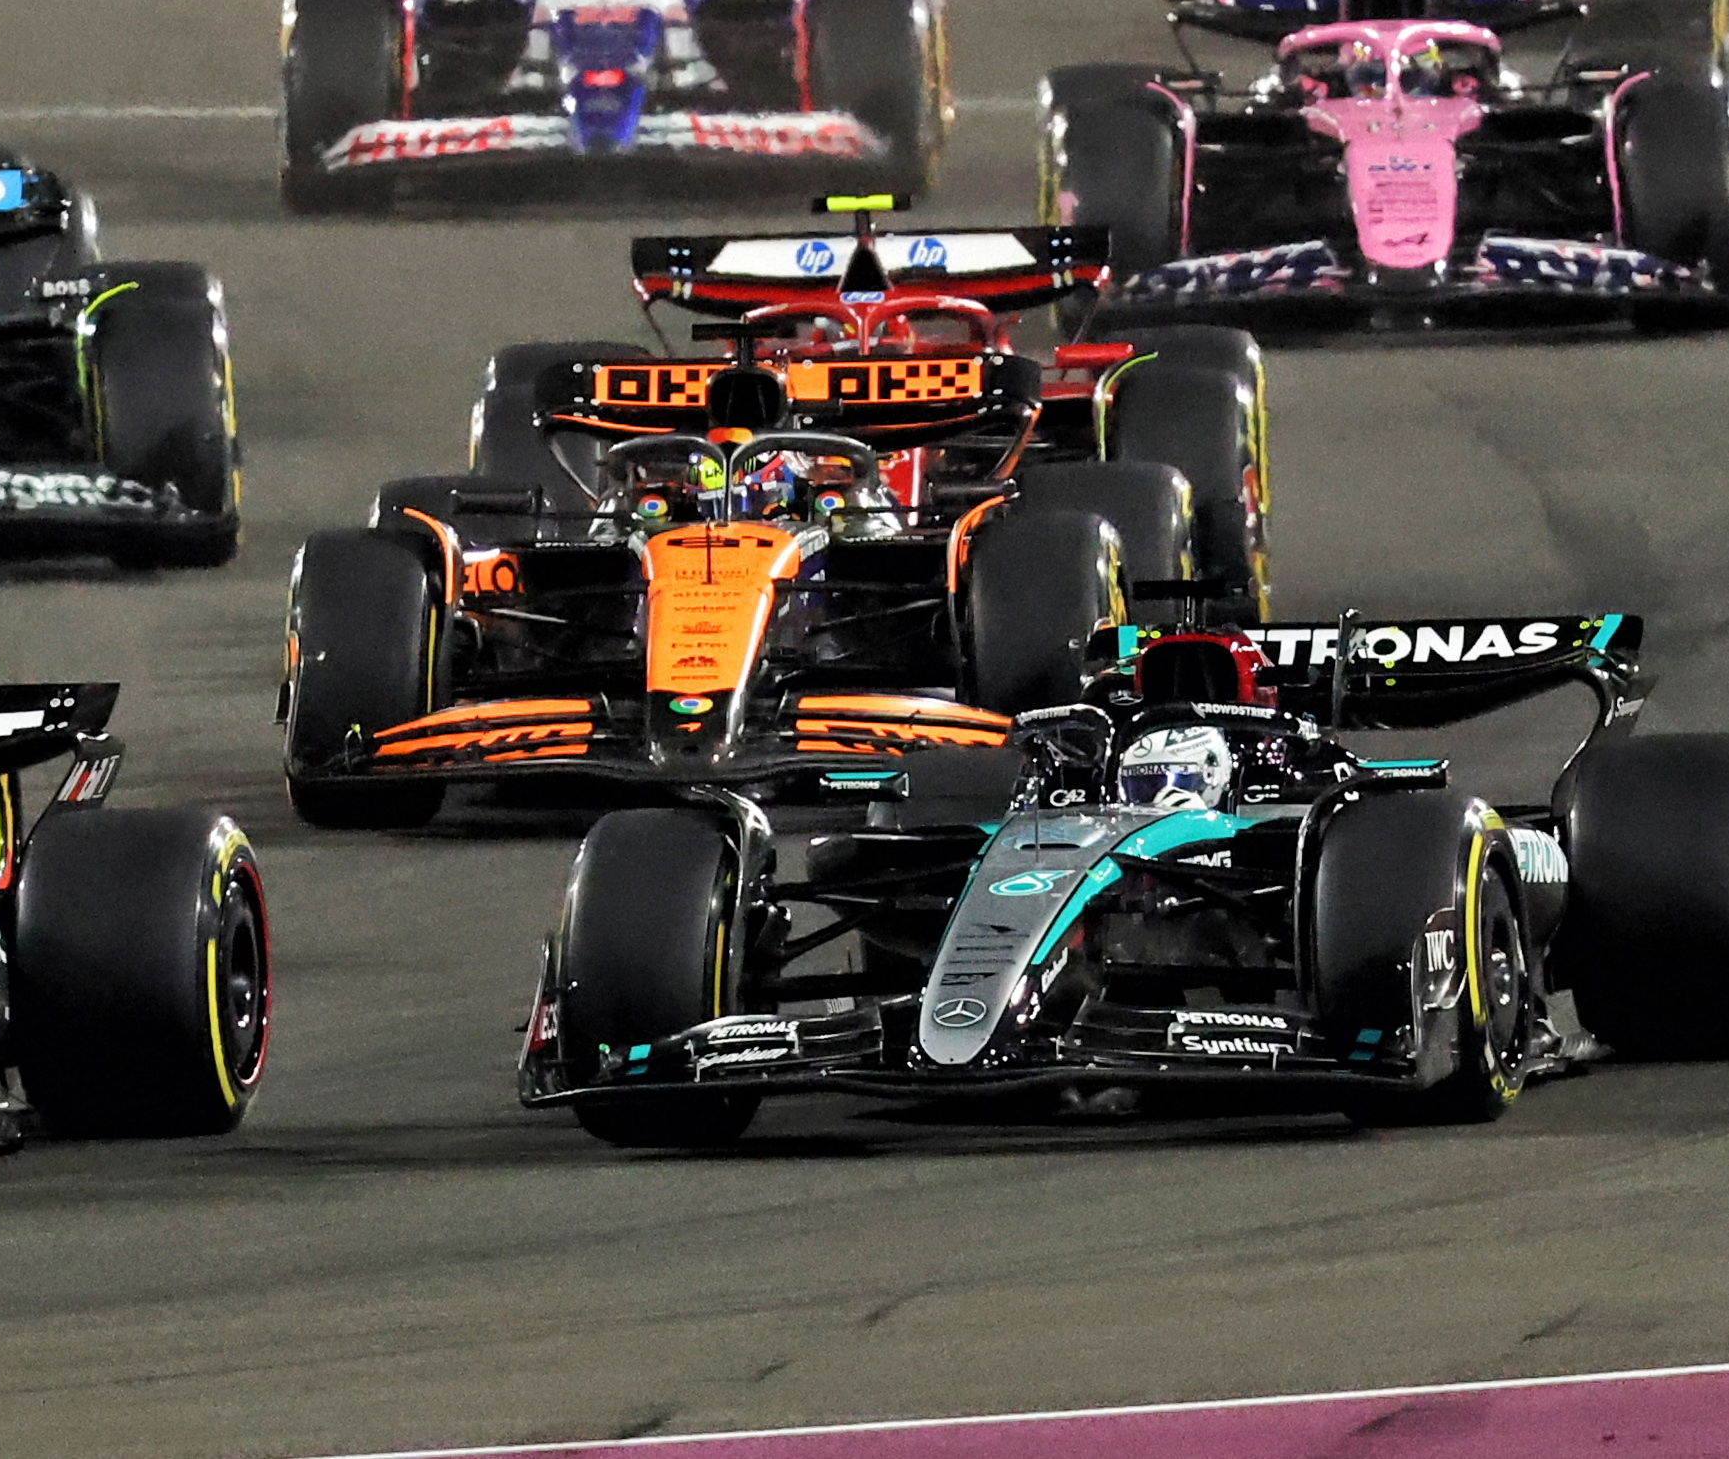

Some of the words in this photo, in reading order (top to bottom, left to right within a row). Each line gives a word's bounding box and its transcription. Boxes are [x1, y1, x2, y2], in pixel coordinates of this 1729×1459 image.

[799, 244, 833, 275] hp
[1048, 788, 1087, 808] G42
[1424, 929, 1456, 973] IWC
[707, 1020, 800, 1040] PETRONAS
[1175, 1011, 1288, 1030] PETRONAS
